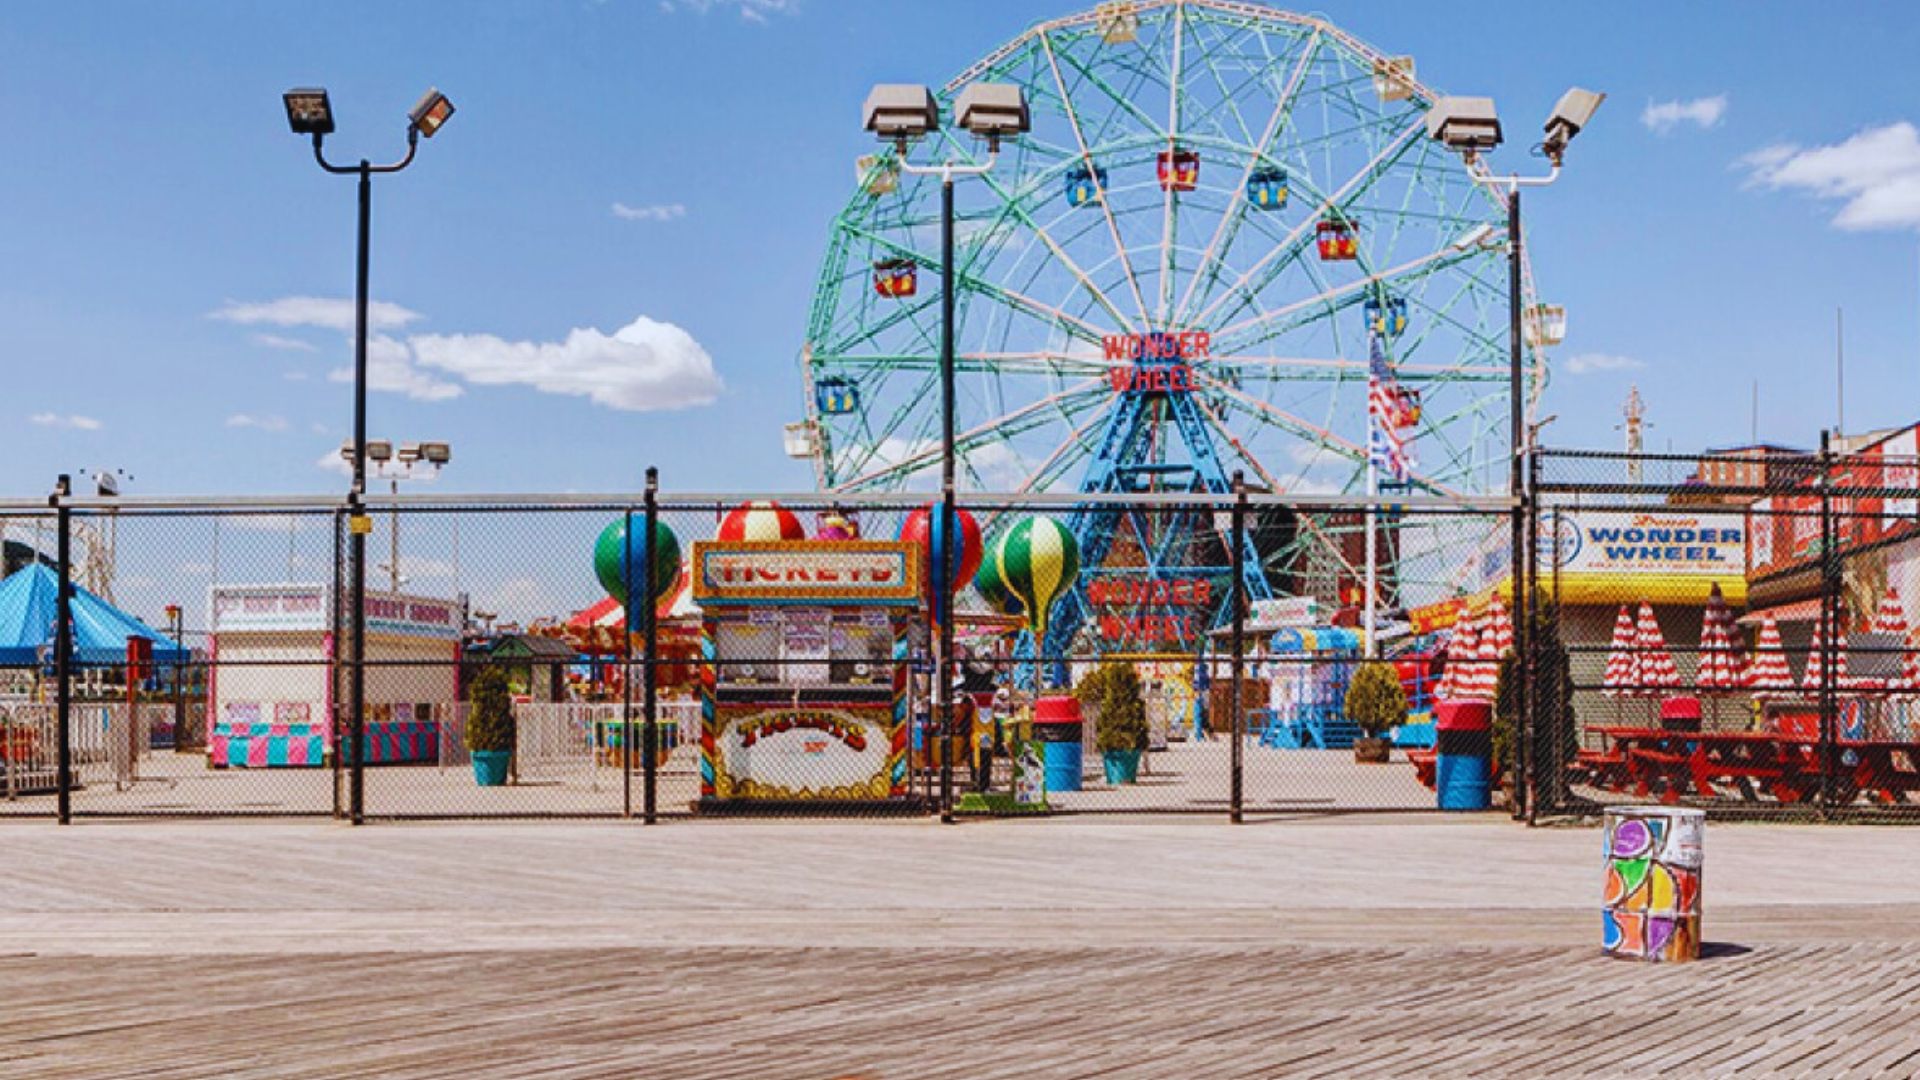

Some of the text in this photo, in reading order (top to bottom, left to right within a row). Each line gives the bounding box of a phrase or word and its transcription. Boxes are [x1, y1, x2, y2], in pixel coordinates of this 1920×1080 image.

[1103, 332, 1210, 360] WONDER
[1110, 365, 1203, 391] WHEEL
[1588, 527, 1742, 544] WONDER
[1605, 546, 1726, 561] WHEEL
[1088, 579, 1211, 606] WONDER
[1101, 615, 1195, 641] WHEEL
